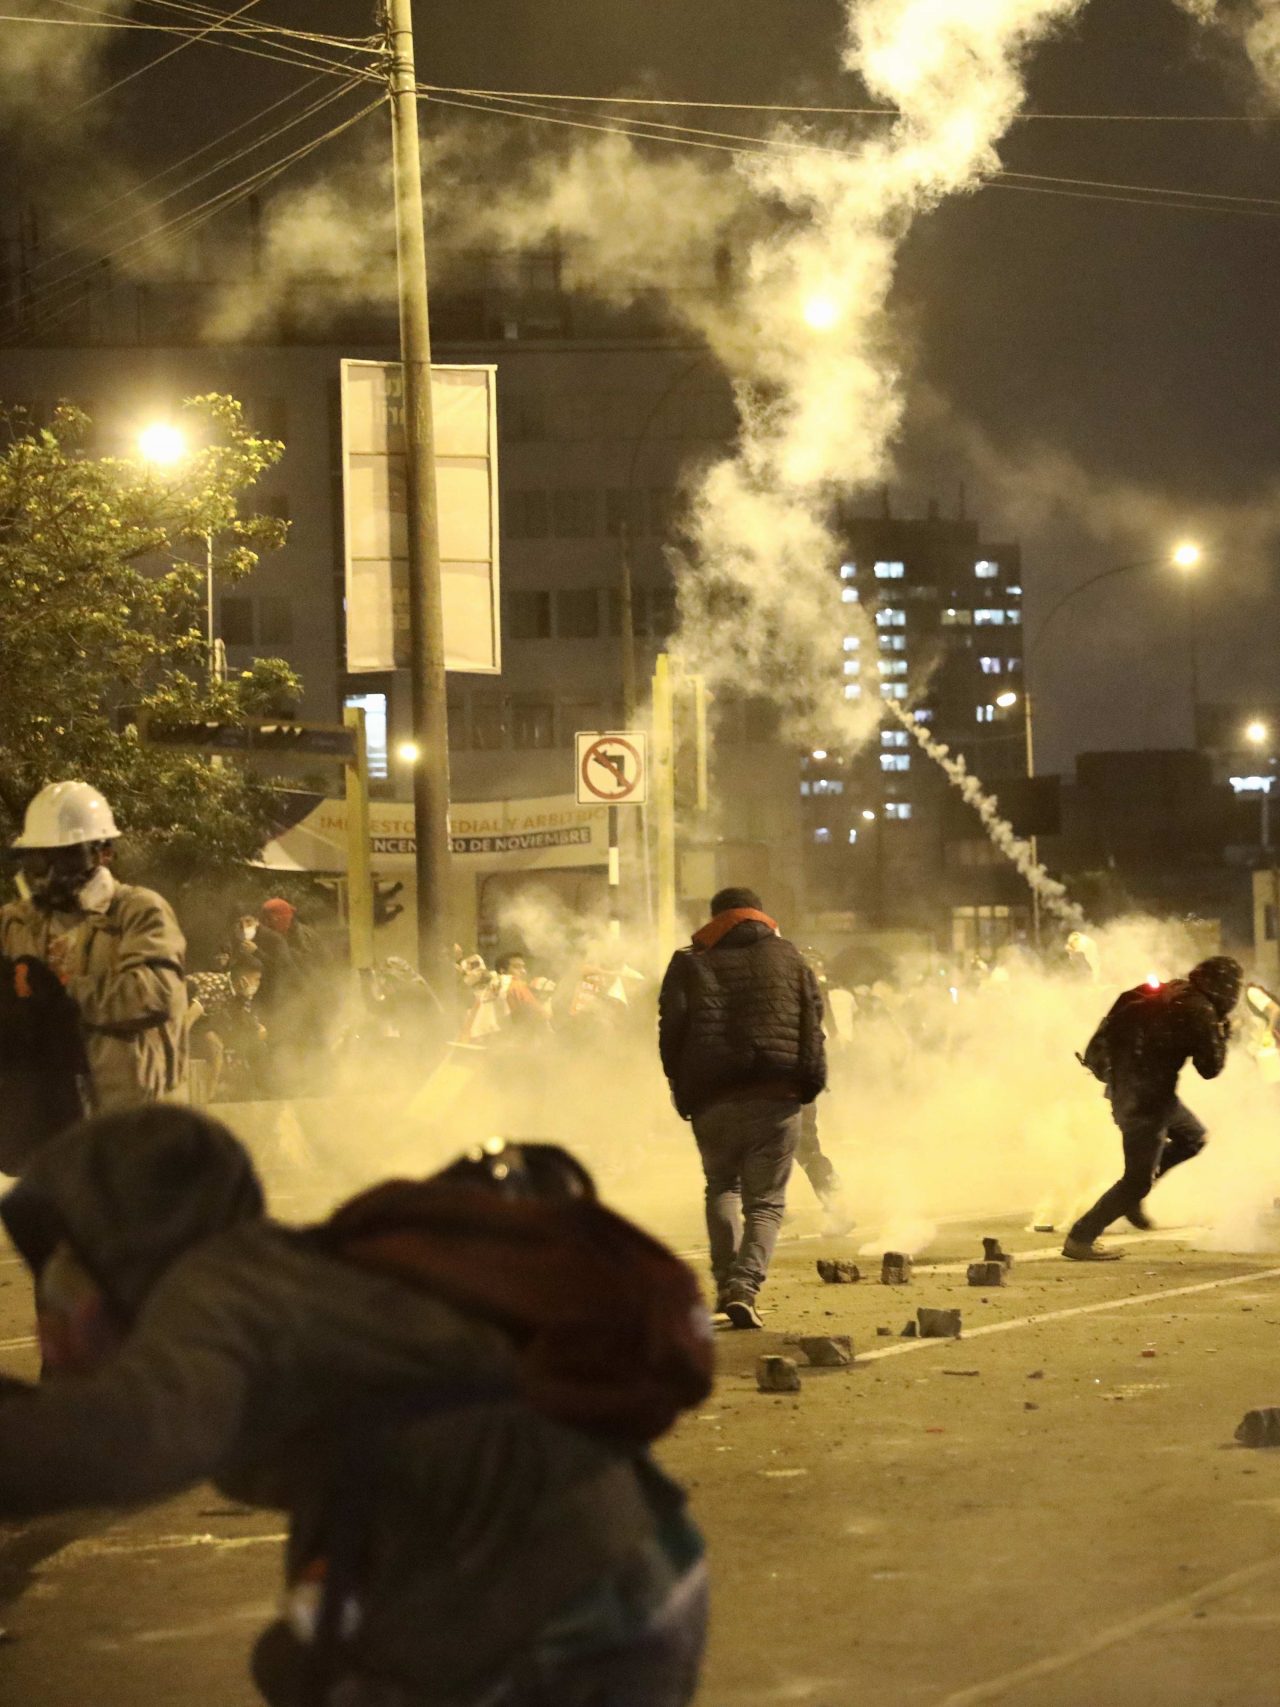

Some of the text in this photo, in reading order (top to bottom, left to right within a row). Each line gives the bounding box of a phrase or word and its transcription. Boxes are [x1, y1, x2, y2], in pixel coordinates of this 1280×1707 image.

[320, 816, 416, 833] IMESTO
[451, 819, 501, 833] EDIAL
[469, 838, 491, 851] DE
[495, 829, 589, 850] NOVIEMBRE
